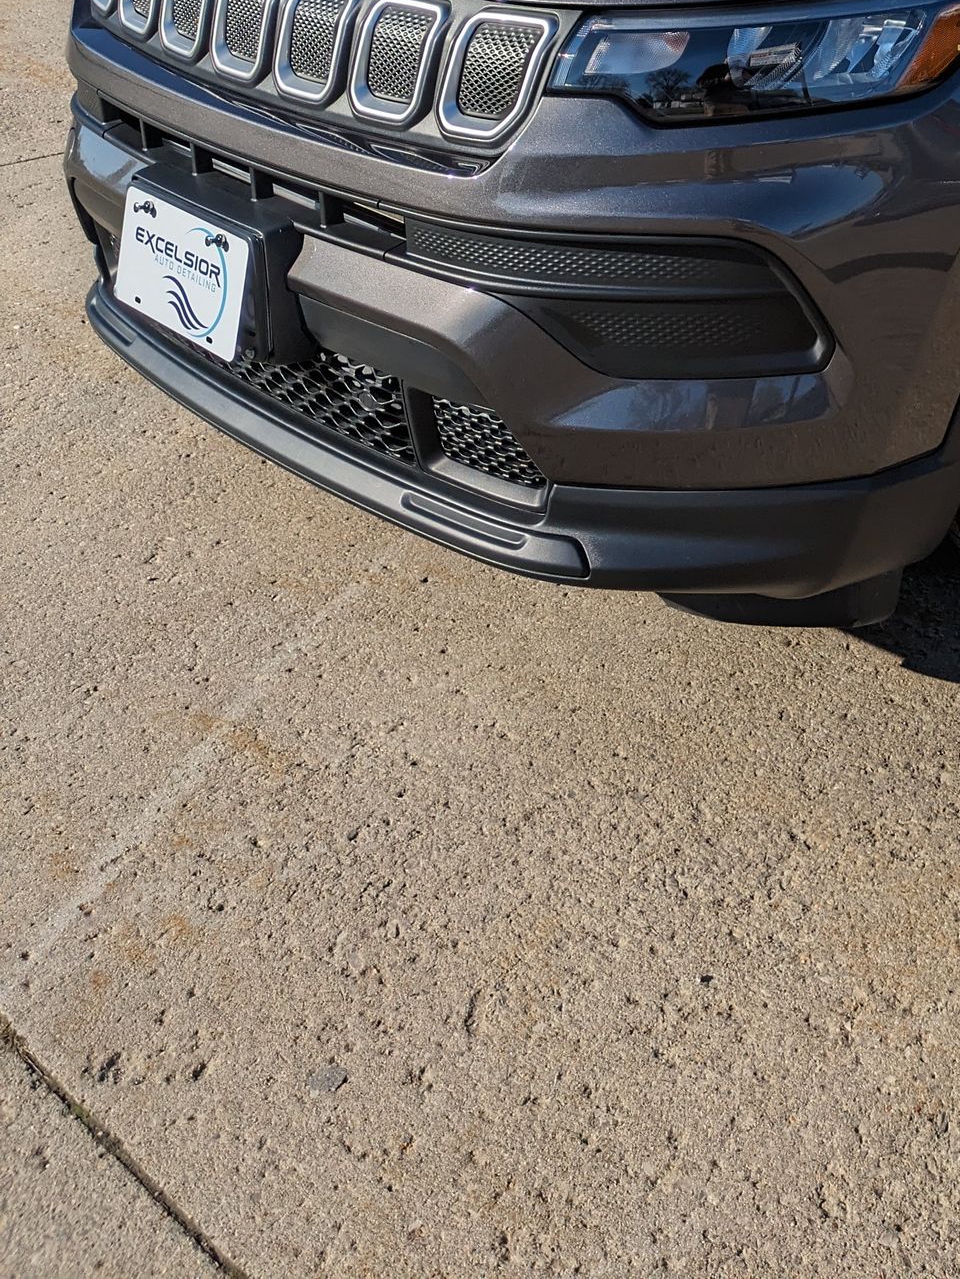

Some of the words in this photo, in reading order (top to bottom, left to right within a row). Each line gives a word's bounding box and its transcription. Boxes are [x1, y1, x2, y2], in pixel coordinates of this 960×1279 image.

[135, 225, 222, 288] EXCELSIOR
[153, 254, 175, 272] AUTO
[176, 265, 217, 294] DETAILING
